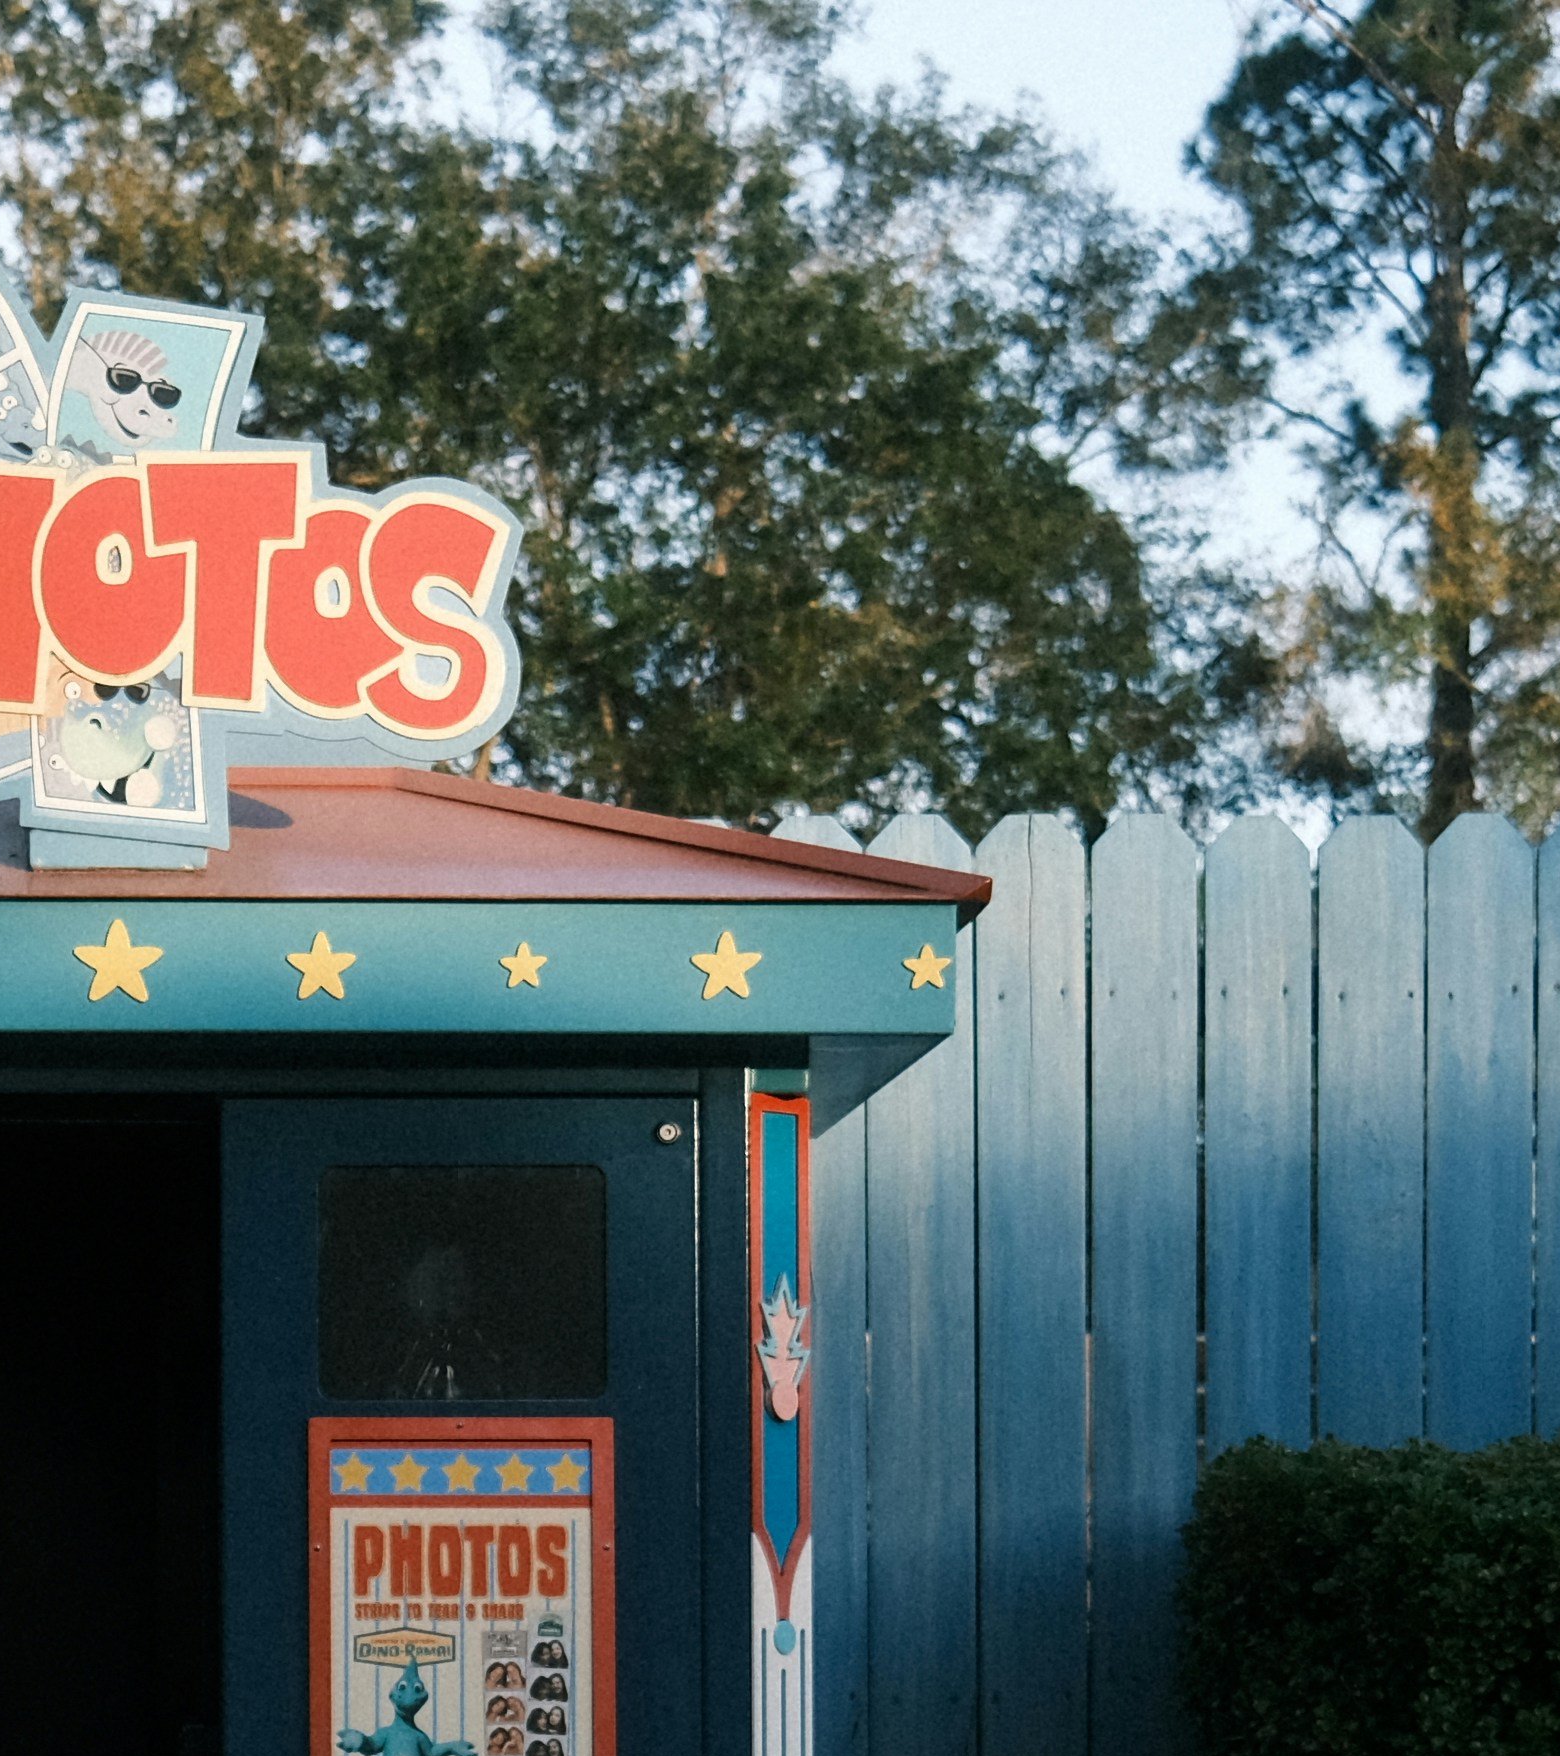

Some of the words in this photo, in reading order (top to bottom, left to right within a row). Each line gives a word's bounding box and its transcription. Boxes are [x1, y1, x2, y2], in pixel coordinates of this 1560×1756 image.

[354, 1525, 566, 1597] PHOTOS
[355, 1603, 401, 1620] STRIPS
[406, 1603, 422, 1620] TO
[428, 1603, 460, 1620] TEAR
[482, 1603, 525, 1621] SHARE
